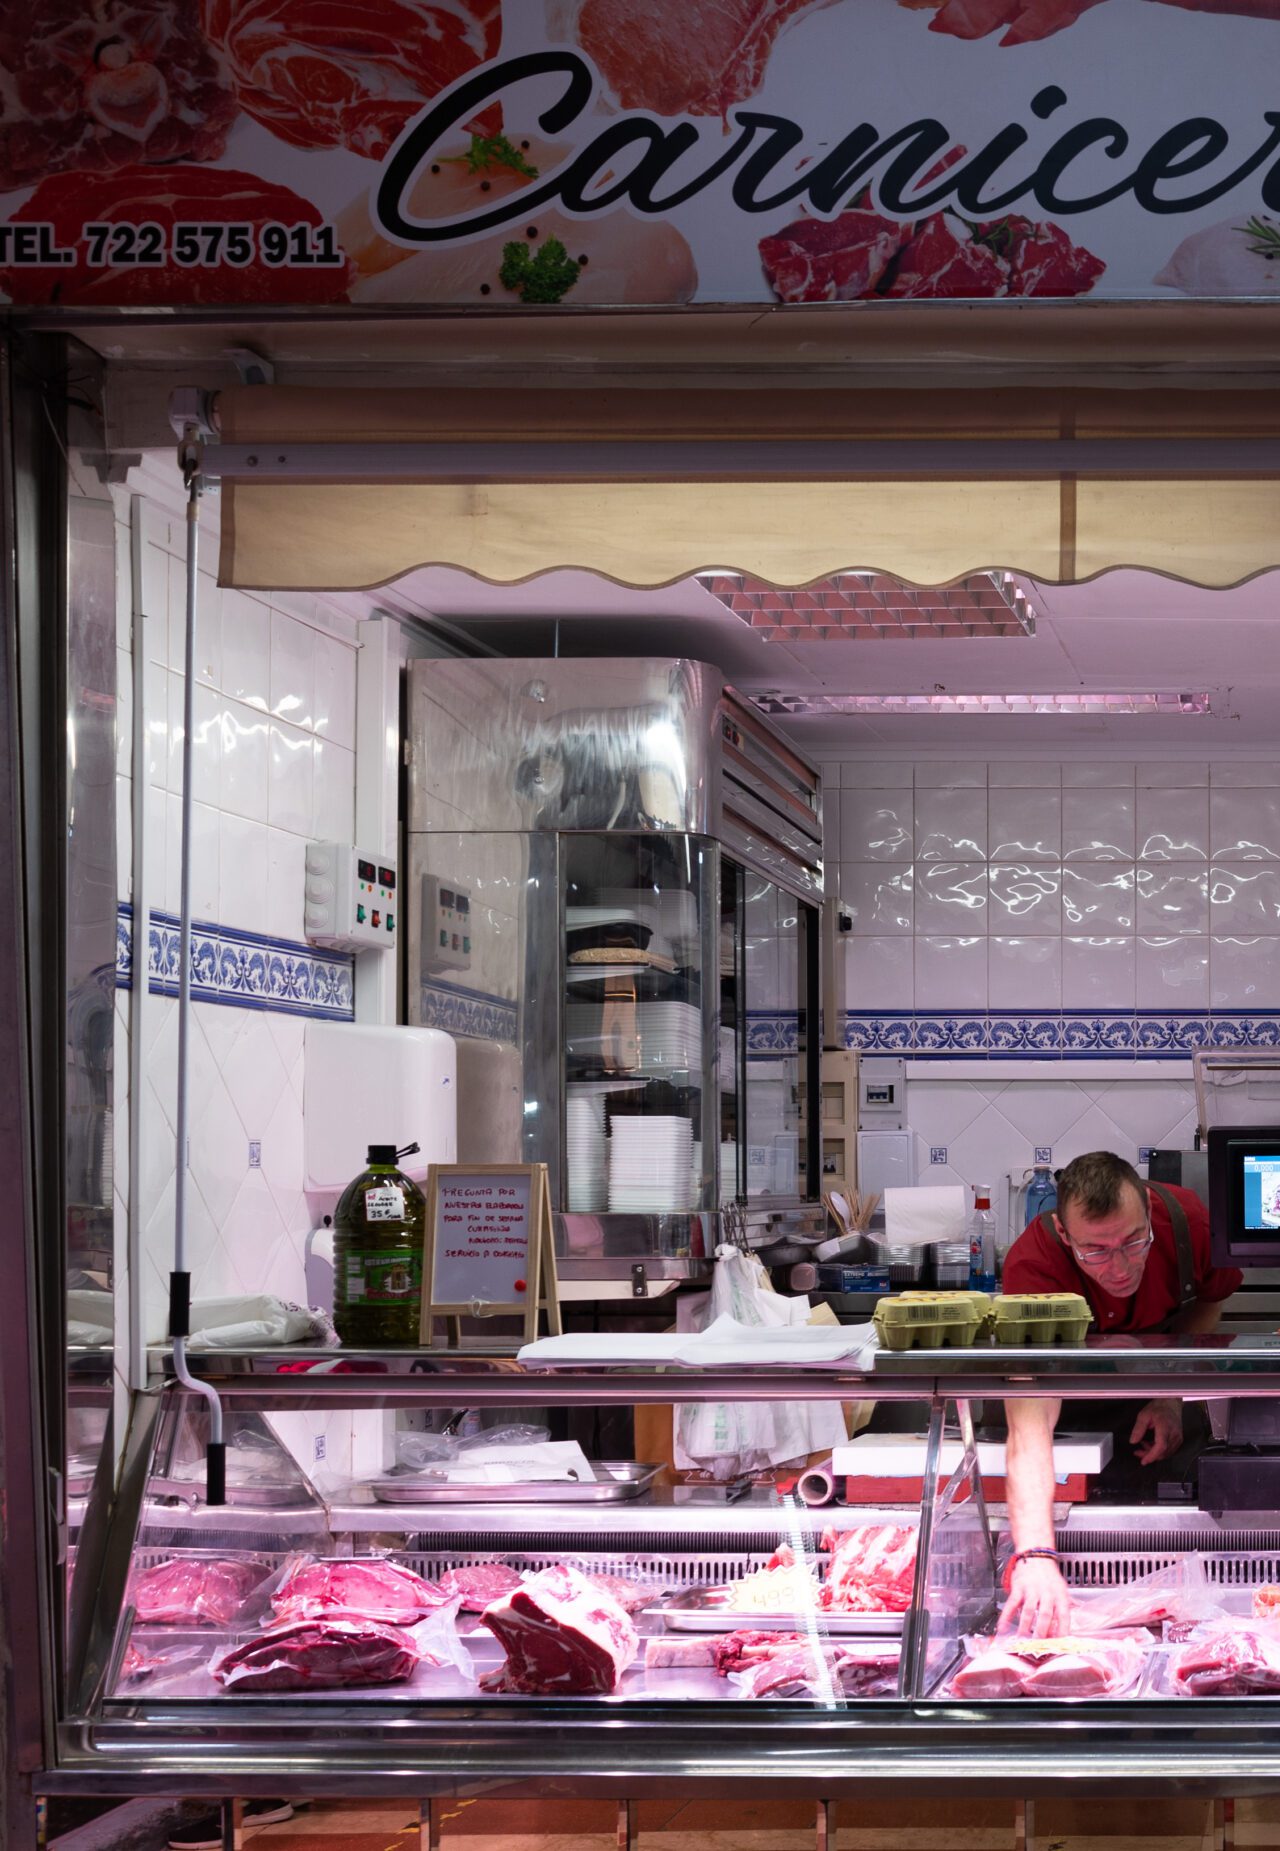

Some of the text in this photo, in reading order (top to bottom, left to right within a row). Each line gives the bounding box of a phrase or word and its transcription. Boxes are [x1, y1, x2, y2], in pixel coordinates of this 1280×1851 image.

[86, 226, 162, 263] 722
[175, 226, 252, 263] 575
[263, 226, 341, 263] 911
[498, 1188, 516, 1196] POR
